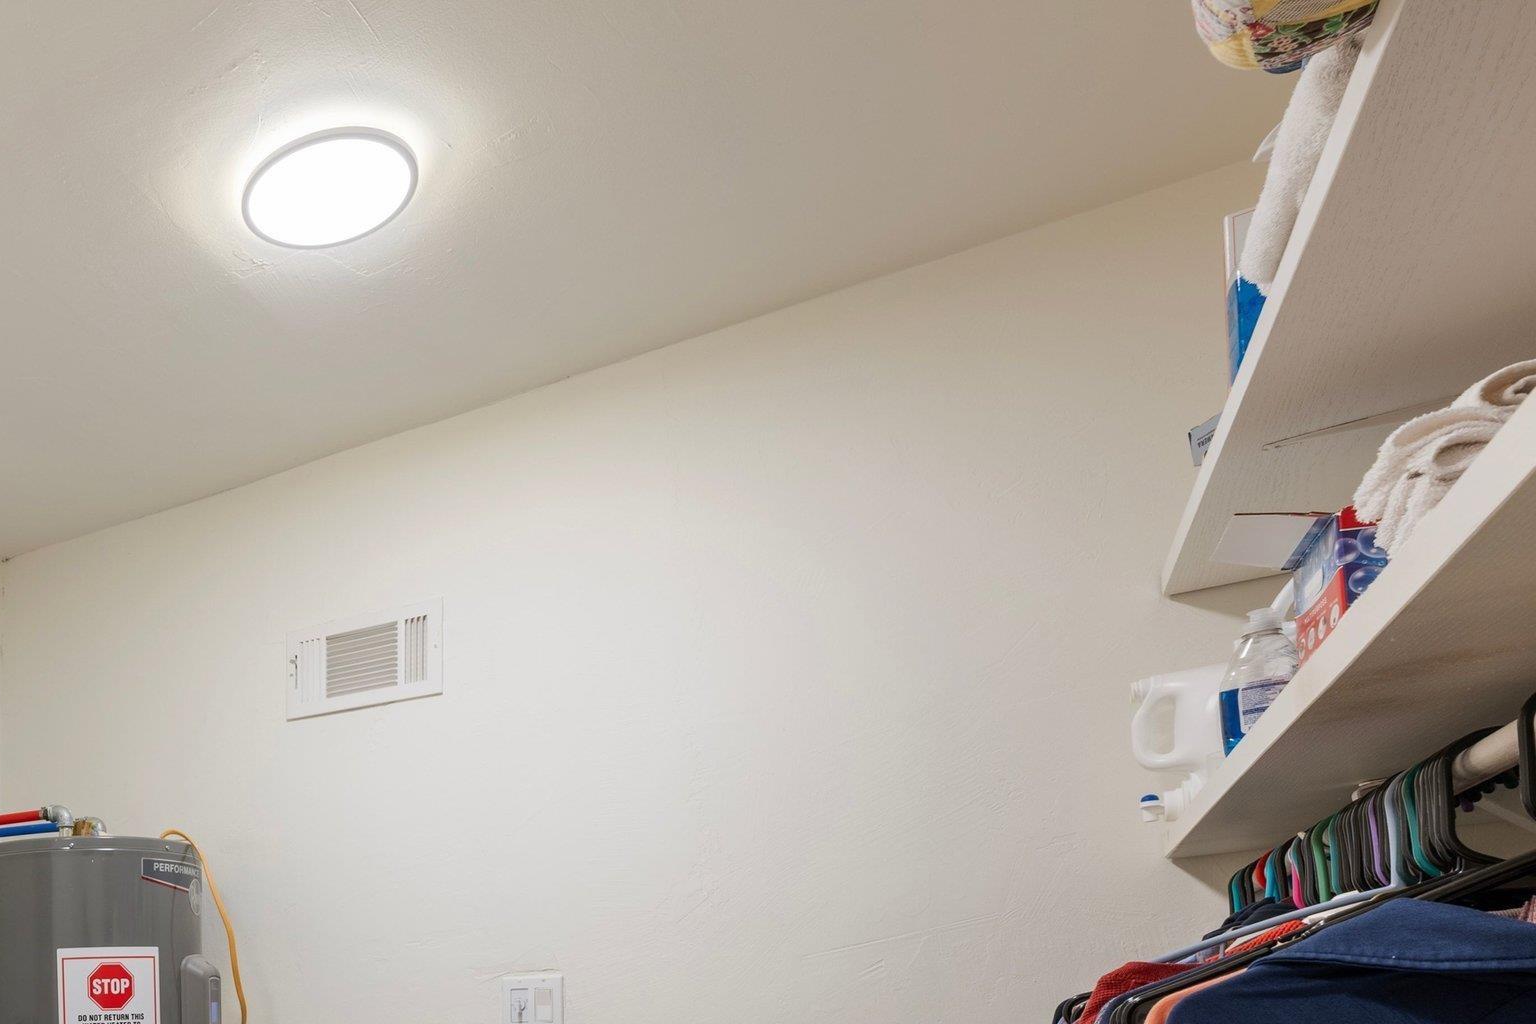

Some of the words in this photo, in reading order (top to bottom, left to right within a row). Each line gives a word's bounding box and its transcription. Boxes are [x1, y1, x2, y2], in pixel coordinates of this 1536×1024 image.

[153, 862, 200, 877] PERFORMANCE
[92, 977, 130, 995] STOP
[77, 1014, 88, 1022] DO
[89, 1014, 102, 1022] NOT
[104, 1013, 130, 1021] RETURN
[131, 1012, 145, 1020] THIS
